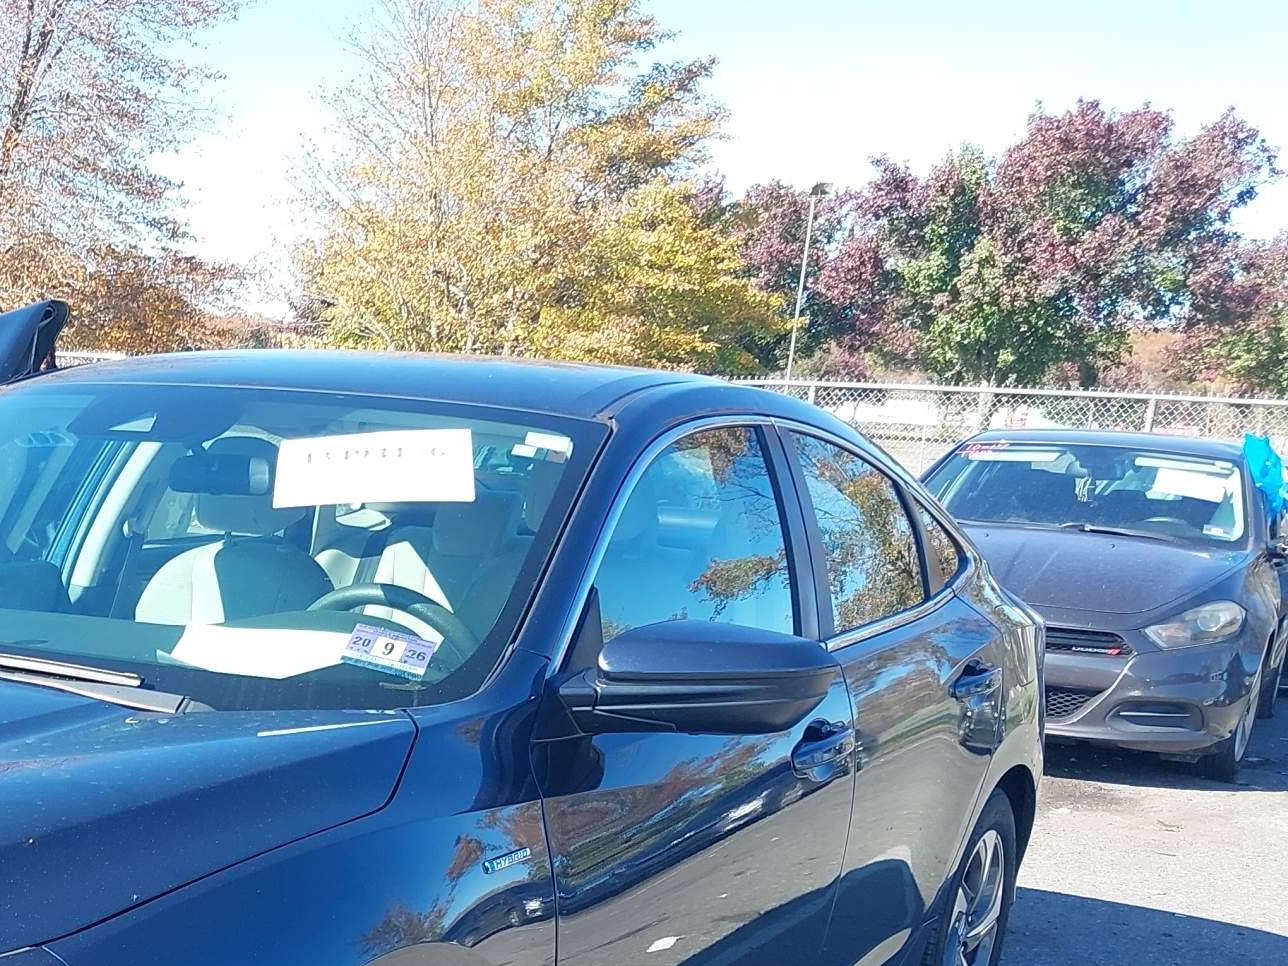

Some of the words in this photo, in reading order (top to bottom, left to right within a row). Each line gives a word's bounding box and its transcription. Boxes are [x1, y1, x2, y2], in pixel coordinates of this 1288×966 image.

[352, 635, 372, 648] 20
[382, 642, 395, 656] 9
[406, 649, 426, 662] 26
